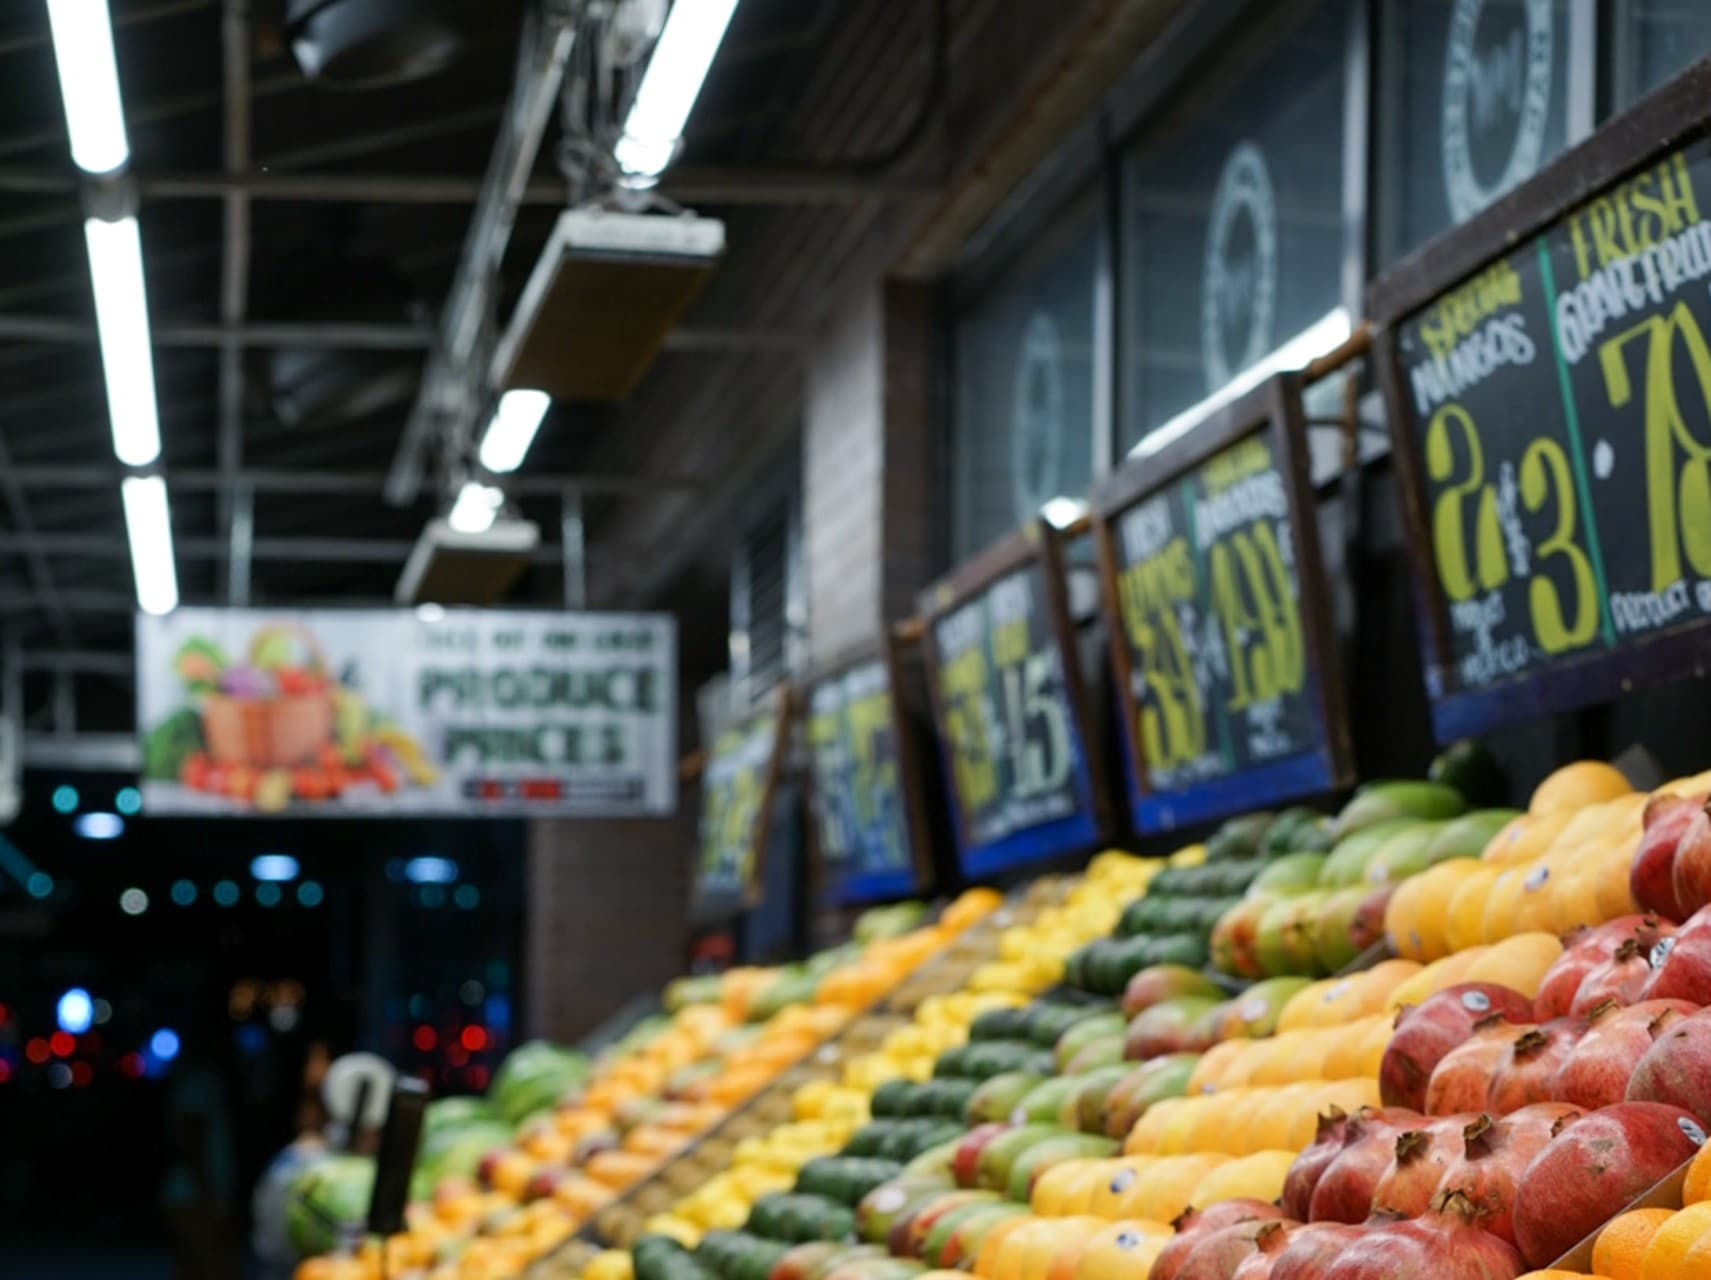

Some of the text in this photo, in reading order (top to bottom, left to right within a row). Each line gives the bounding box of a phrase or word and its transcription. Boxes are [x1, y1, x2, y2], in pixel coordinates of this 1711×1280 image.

[1569, 152, 1701, 281] FRESH
[1557, 219, 1711, 364] GRAPEFRUI
[1411, 312, 1537, 418] MANGOS
[418, 666, 658, 714] PRODUCE
